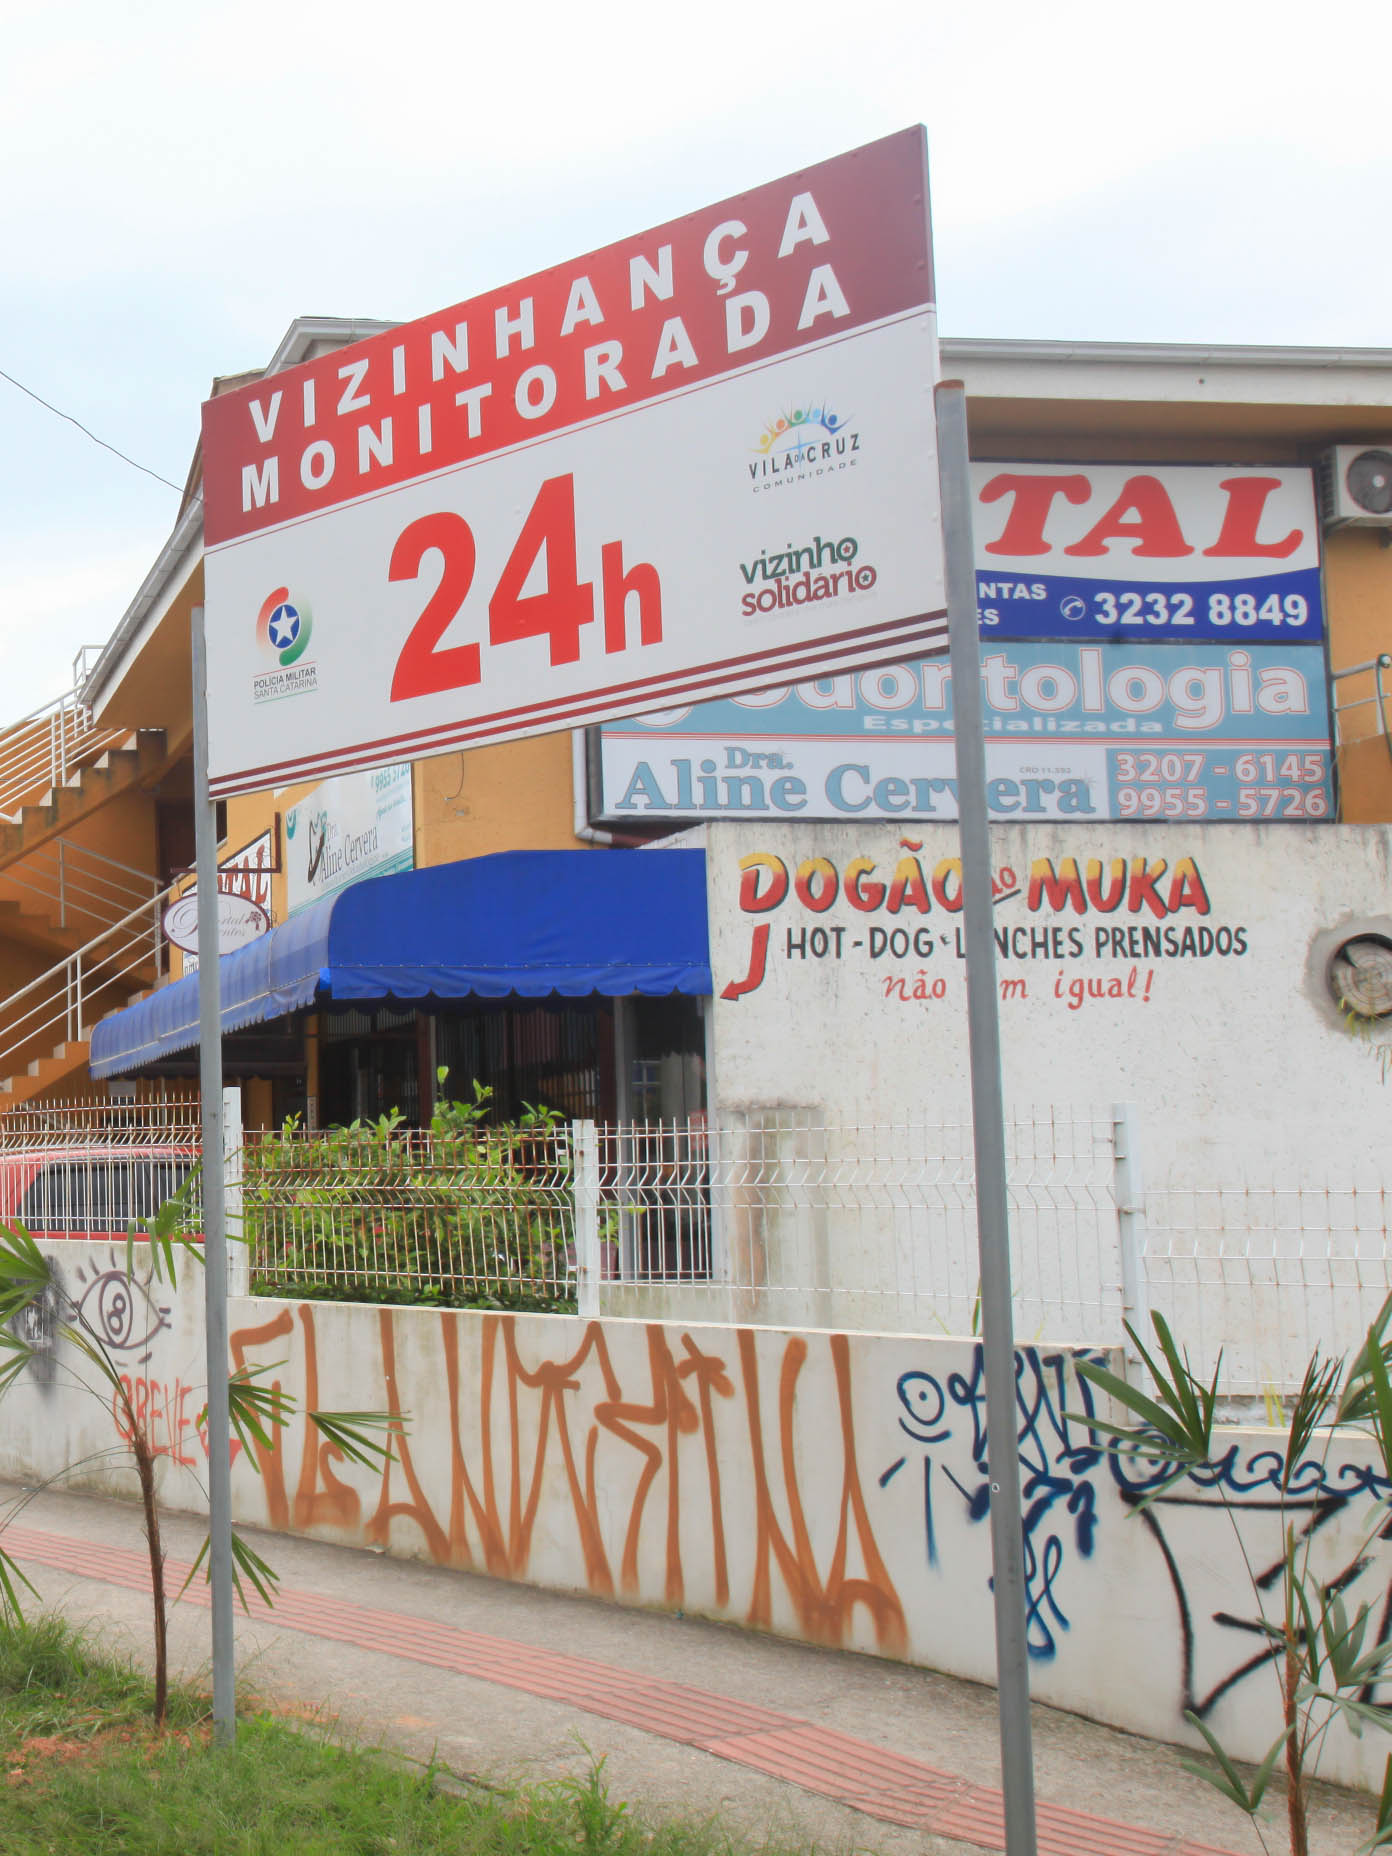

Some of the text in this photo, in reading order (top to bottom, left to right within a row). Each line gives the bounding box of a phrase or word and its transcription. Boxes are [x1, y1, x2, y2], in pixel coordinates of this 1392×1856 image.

[249, 191, 831, 444] VIZINHANÇA
[241, 263, 851, 513] MONITORADA
[749, 453, 794, 480] VILA
[807, 432, 860, 463] CRUZ
[752, 458, 858, 493] COMUNIDADE
[739, 535, 859, 585] vizinho
[388, 471, 664, 704] 24h
[741, 560, 878, 617] solidário
[1094, 592, 1309, 626] 3232 8849
[285, 666, 317, 683] MILITAR
[863, 715, 1164, 734] Espeializada
[723, 746, 794, 770] Dra.
[1115, 752, 1206, 784] 3207
[1234, 752, 1325, 784] 6145
[614, 759, 807, 812] Aline
[1118, 787, 1207, 817] 9955
[1237, 787, 1329, 818] 5726
[344, 826, 378, 867] Cervera
[738, 836, 964, 915] DOGÃO
[1027, 857, 1211, 919] MUKA
[786, 926, 934, 960] HOT-DOG
[955, 926, 1084, 960] LNCHES
[1095, 926, 1248, 959] PRENSADOS
[882, 969, 946, 1002] não
[1054, 965, 1154, 1011] igual!
